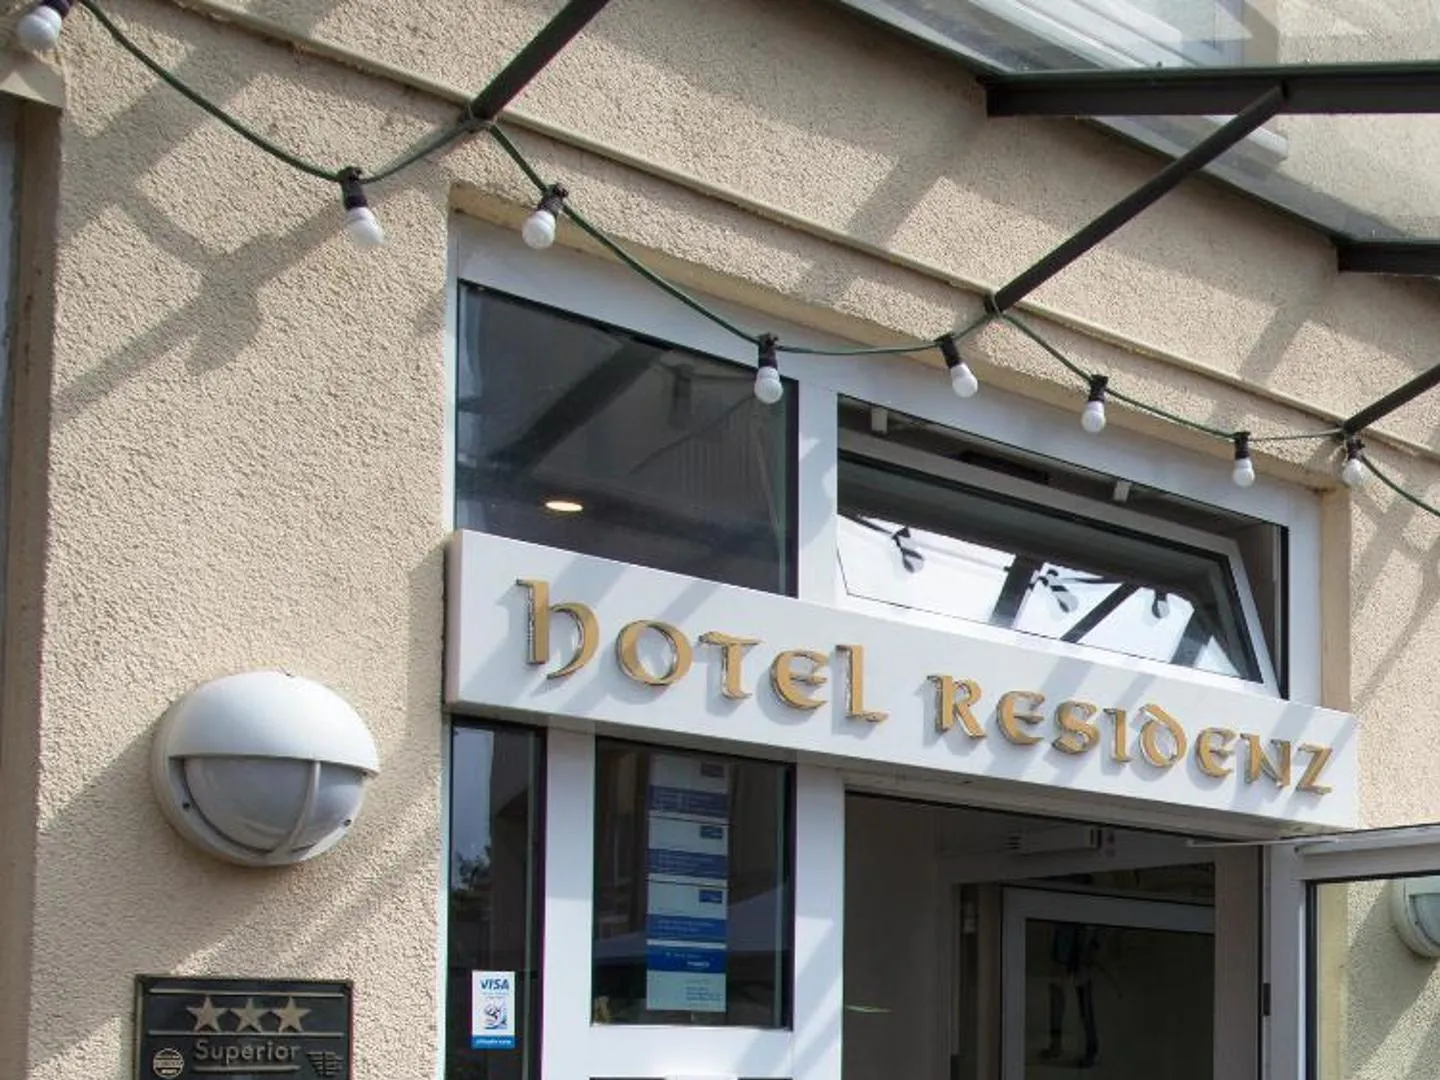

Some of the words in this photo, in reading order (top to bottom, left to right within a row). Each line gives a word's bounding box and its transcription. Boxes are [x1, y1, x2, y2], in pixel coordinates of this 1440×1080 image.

[515, 576, 888, 724] HOTEL
[926, 672, 1334, 796] RESIDENZ
[480, 979, 509, 991] VISA
[195, 1040, 299, 1065] Superior
